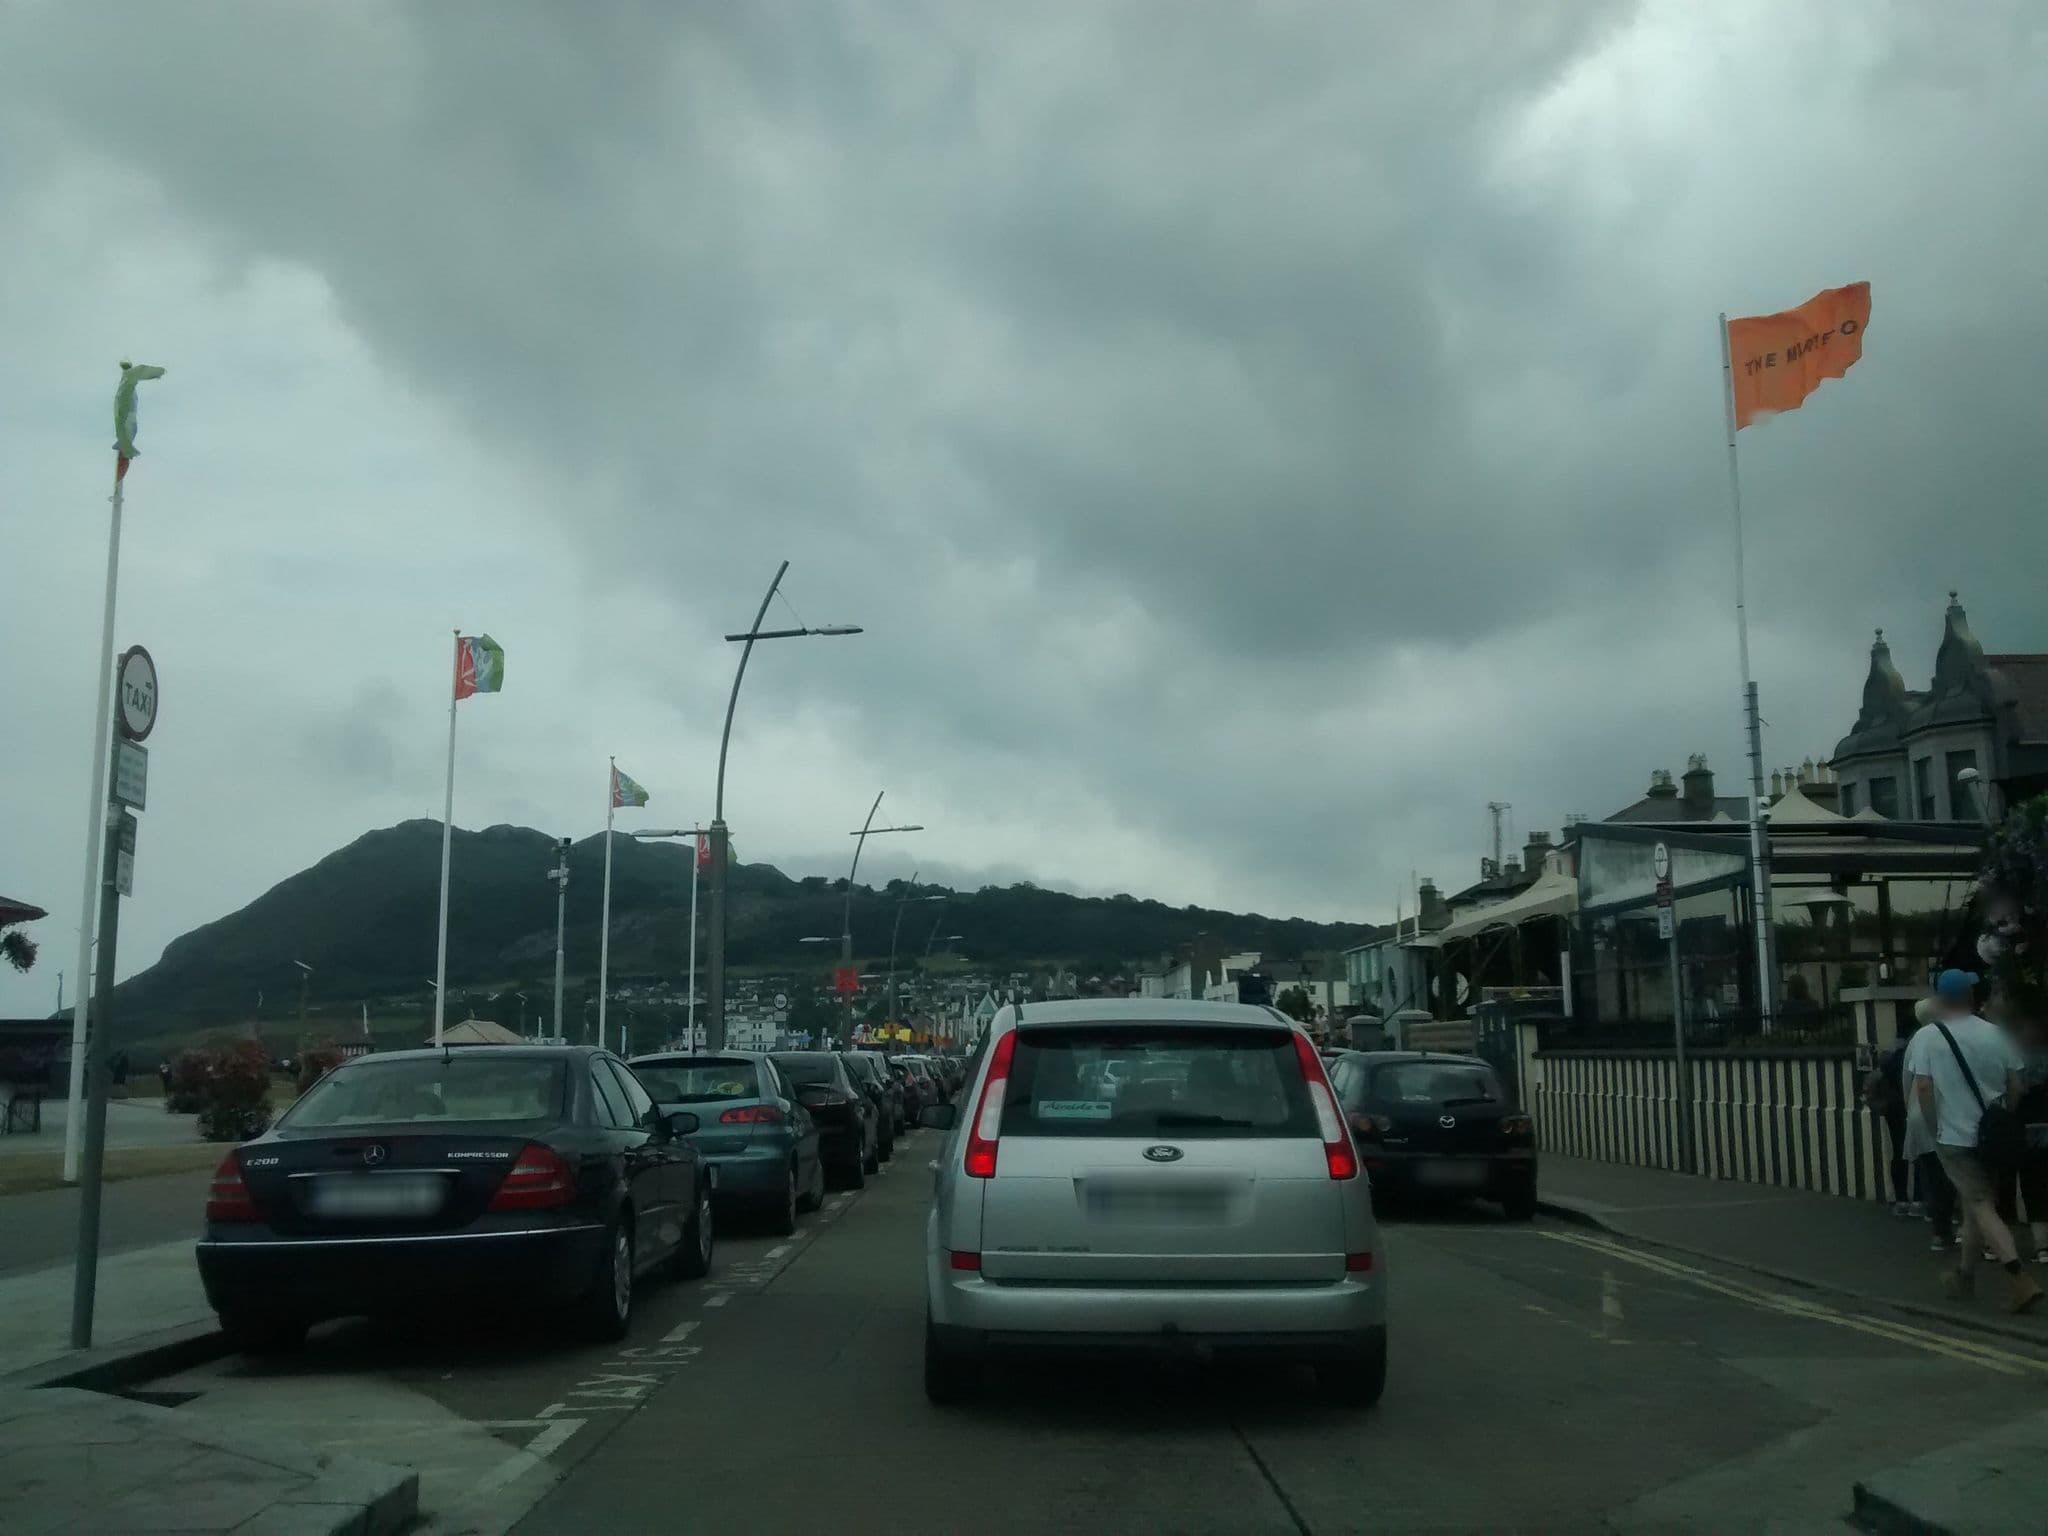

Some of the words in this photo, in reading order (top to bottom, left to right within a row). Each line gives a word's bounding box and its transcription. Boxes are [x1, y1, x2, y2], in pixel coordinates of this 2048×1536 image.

[1744, 352, 1777, 376] THE
[125, 682, 152, 719] TAXI
[447, 1151, 510, 1160] KOMPRESSOR
[535, 1345, 704, 1419] TAXIS
